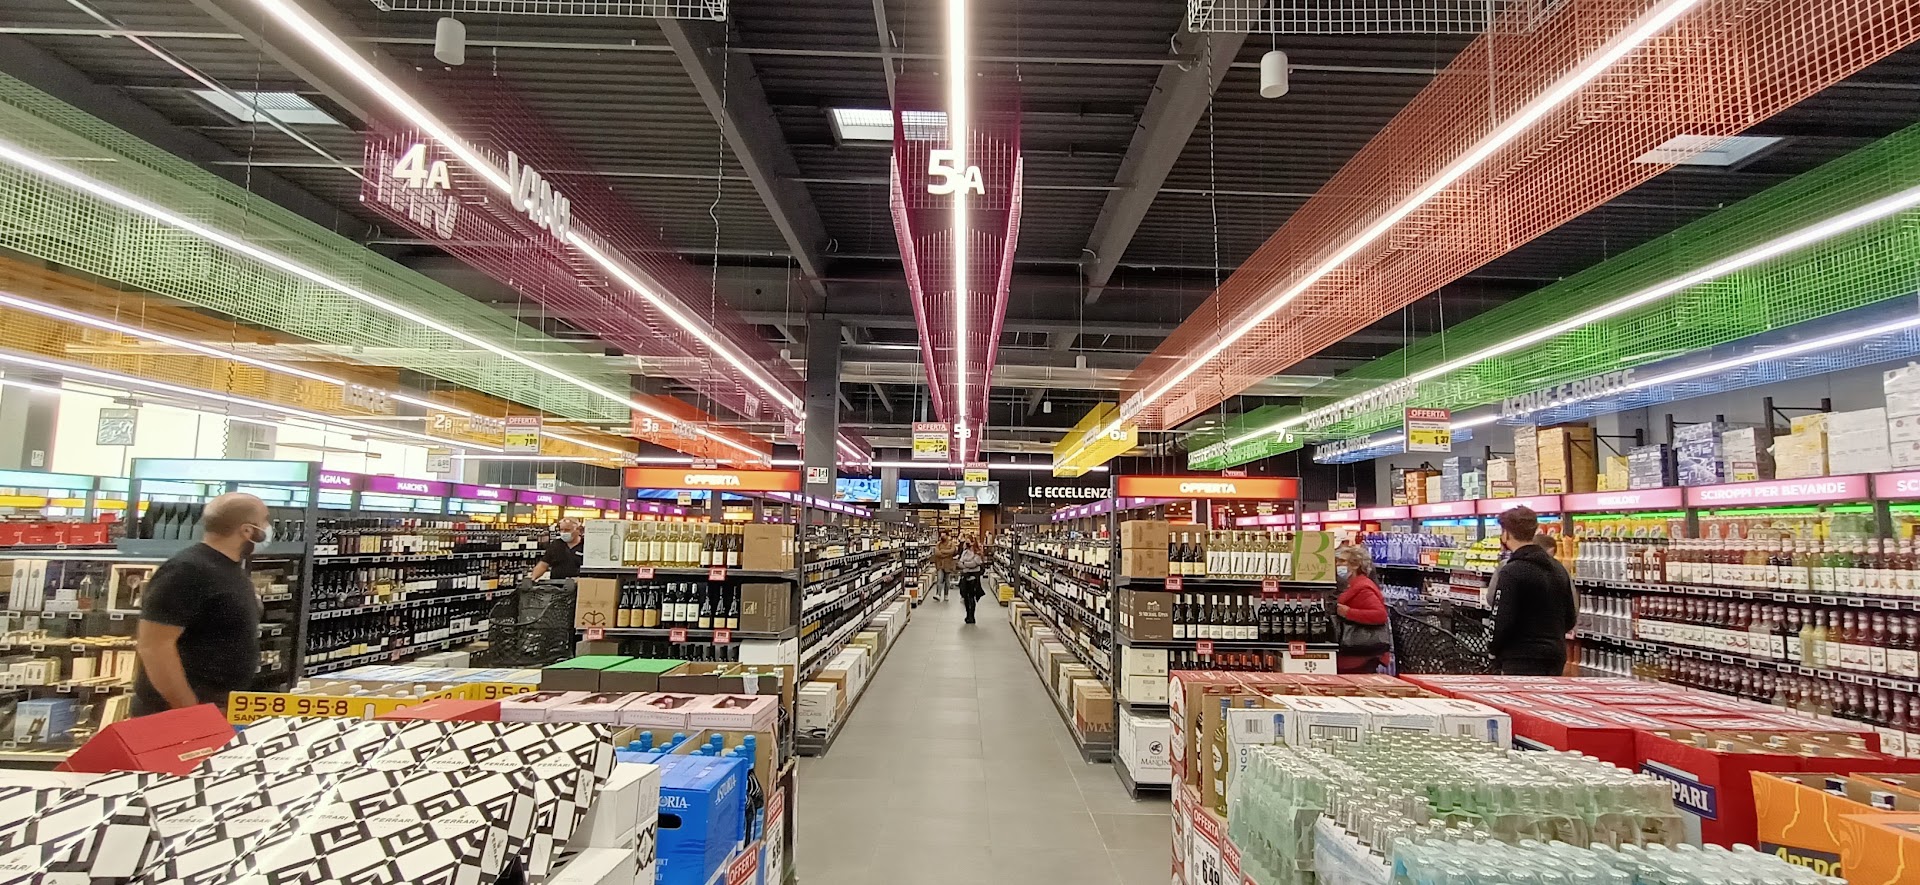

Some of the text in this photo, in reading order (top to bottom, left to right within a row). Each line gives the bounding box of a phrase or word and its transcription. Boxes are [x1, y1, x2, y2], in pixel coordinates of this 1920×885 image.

[393, 144, 450, 189] 4A
[927, 150, 984, 195] 5A
[508, 151, 570, 244] VINI
[1501, 388, 1553, 417] ACQUE
[1410, 409, 1446, 418] OFFERTA
[642, 418, 659, 432] 3B
[917, 423, 947, 431] OFFERTA
[1110, 430, 1127, 441] 6B
[1275, 429, 1293, 443] 7B
[684, 474, 740, 486] OFFERTA
[1028, 486, 1112, 499] LE ECCELLENZE
[1179, 483, 1236, 494] OFFERTA
[1700, 482, 1846, 500] SCIROPPI PER BEVANDE
[1641, 768, 1709, 811] PARI
[1193, 809, 1219, 838] OFFERTA
[730, 849, 756, 878] OFFERTA
